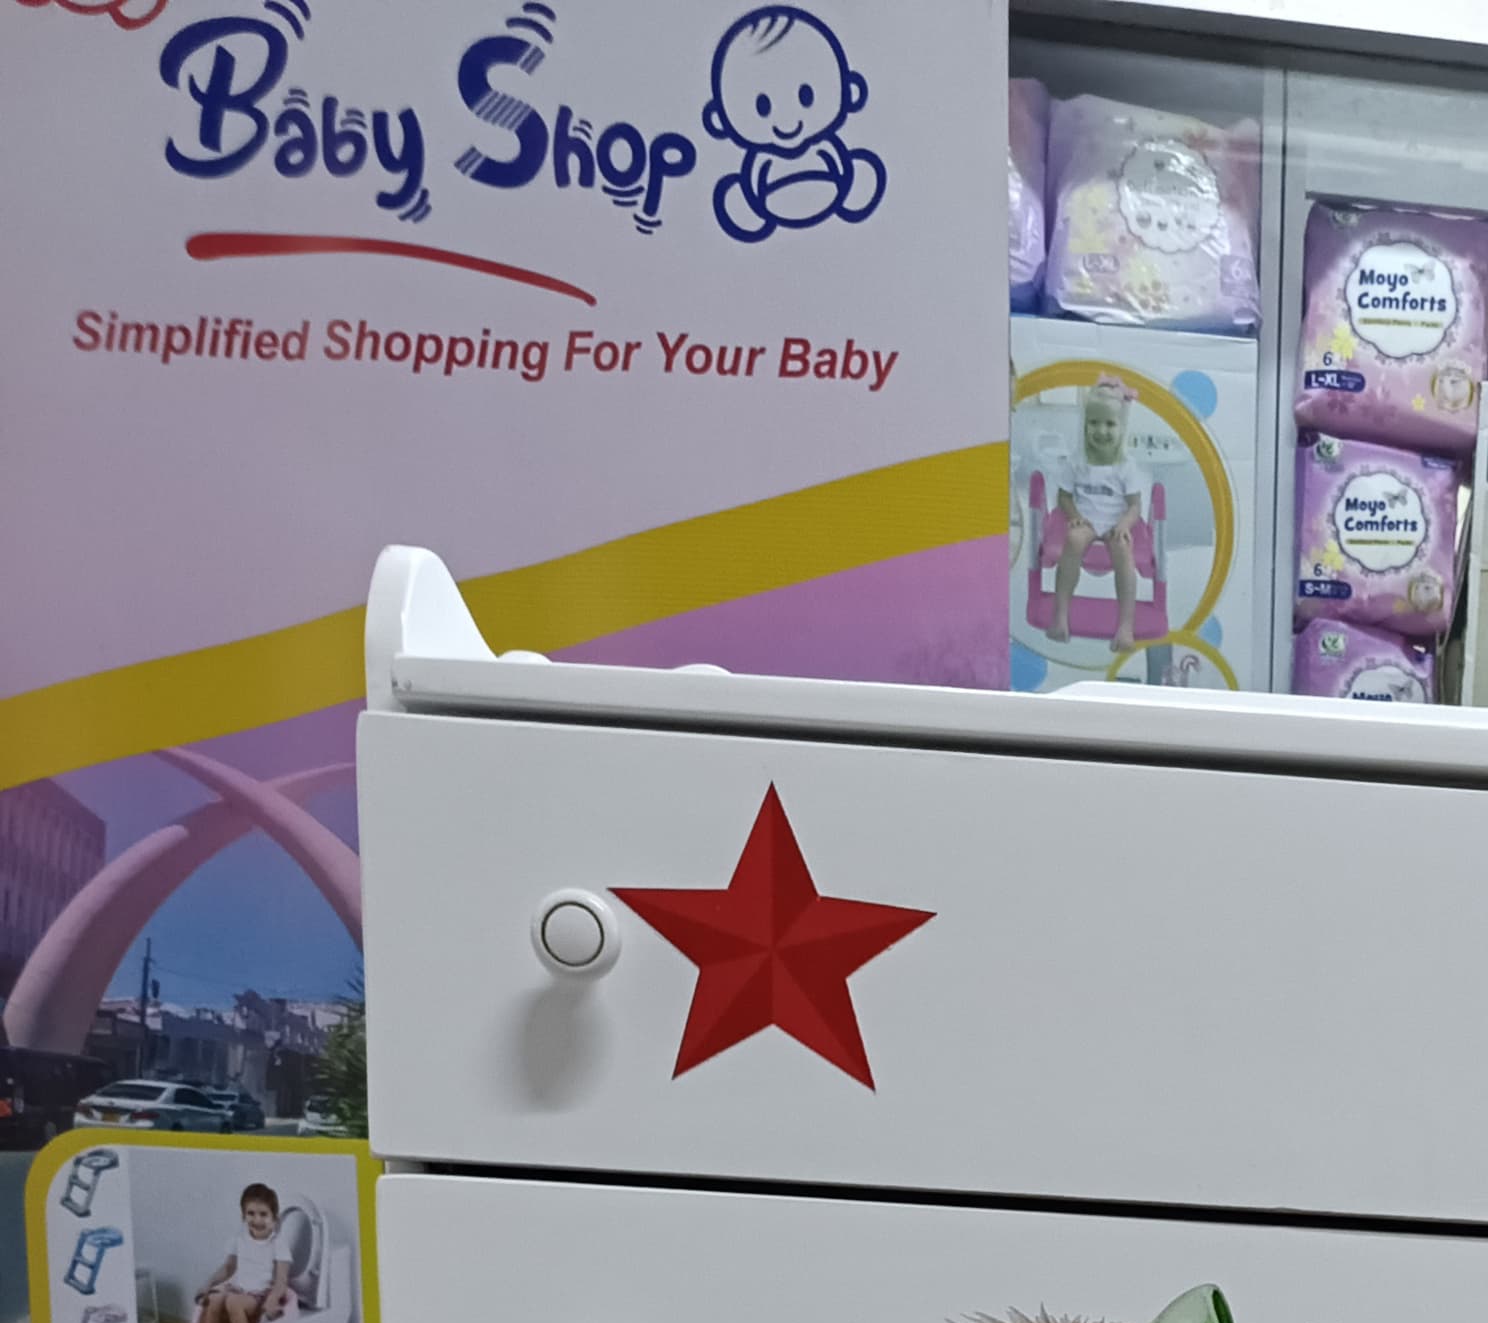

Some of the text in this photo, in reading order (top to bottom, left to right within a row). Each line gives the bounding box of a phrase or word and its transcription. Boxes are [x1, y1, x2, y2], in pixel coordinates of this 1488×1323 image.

[159, 16, 697, 217] Baby Shop
[1358, 269, 1409, 293] Moyo
[1357, 291, 1447, 313] Comforts
[72, 309, 899, 392] Simplified Shopping For Your Baby
[1322, 351, 1334, 366] 6
[1344, 497, 1386, 516] Moyo
[1343, 514, 1418, 532] Comforts
[1313, 562, 1323, 576] 6
